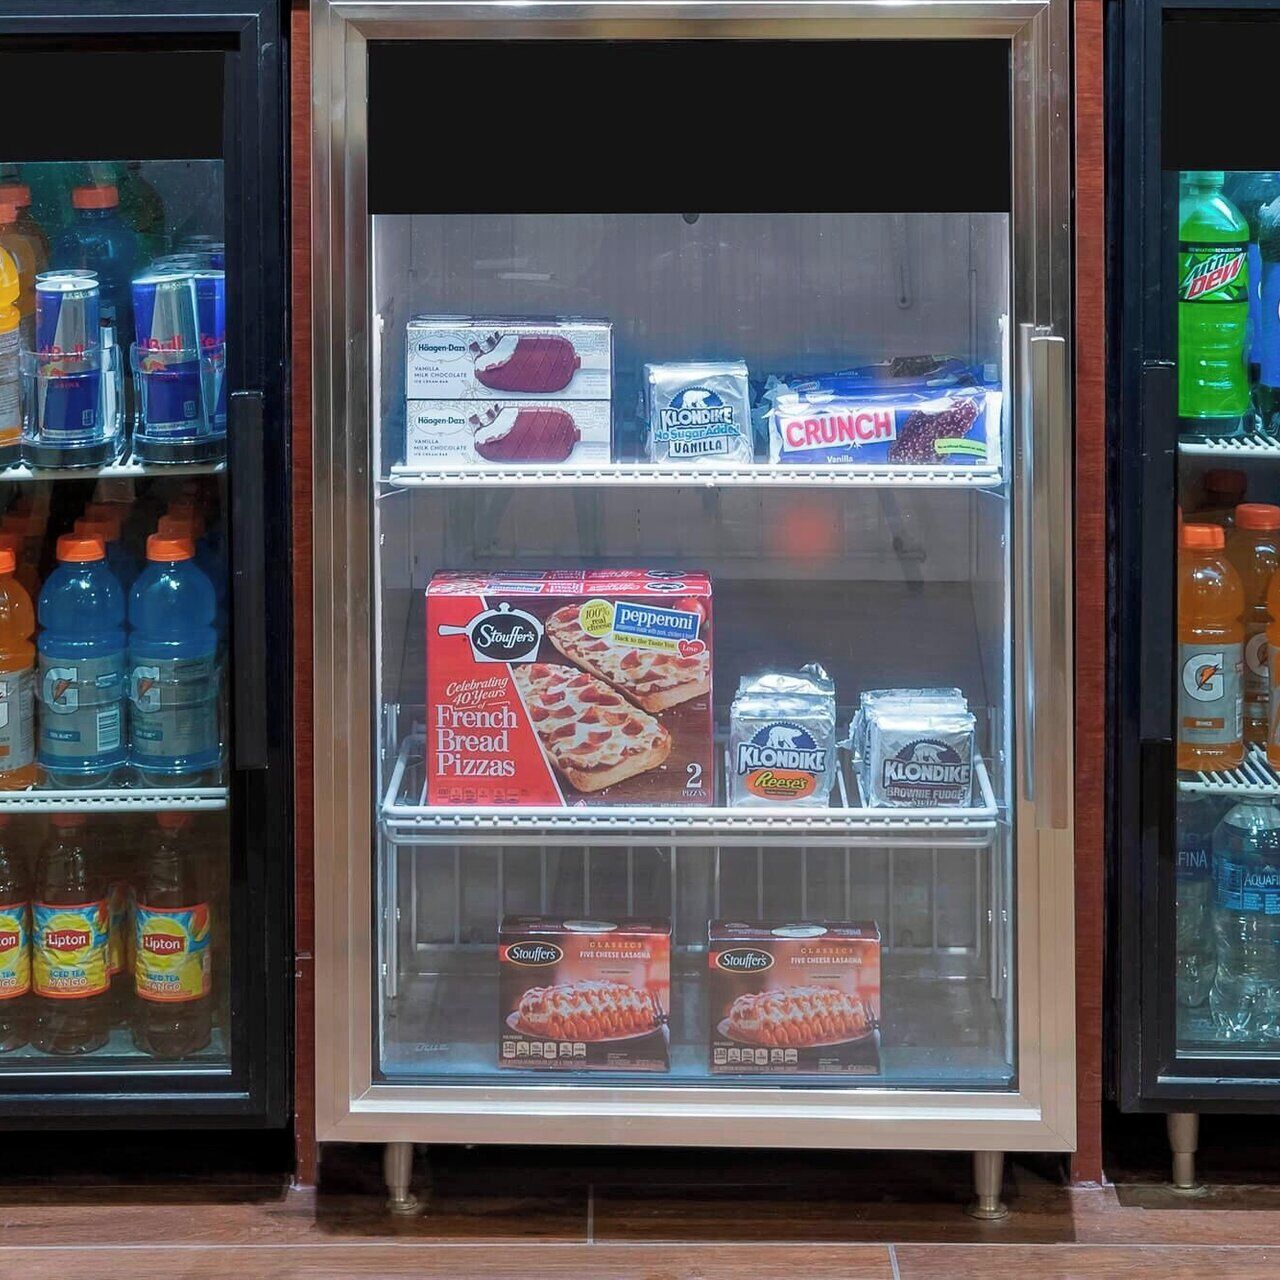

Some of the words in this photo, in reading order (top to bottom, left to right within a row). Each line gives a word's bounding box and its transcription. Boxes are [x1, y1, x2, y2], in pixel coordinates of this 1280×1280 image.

[660, 406, 733, 432] KLONDIKE
[655, 429, 669, 441] No
[670, 427, 706, 441] Sugar
[785, 411, 892, 448] CRUNCH
[674, 440, 723, 453] VANILLA
[827, 454, 853, 463] Vanilla
[621, 608, 693, 629] pepperoni
[477, 624, 534, 648] Stouffer's
[446, 676, 508, 697] Celebrating
[454, 694, 471, 706] 40
[471, 688, 506, 705] Years
[478, 702, 486, 710] of
[435, 705, 518, 728] French
[435, 728, 509, 752] Bread
[435, 753, 515, 777] Pizzas
[739, 743, 825, 774] KLONDIKE
[685, 763, 703, 788] 2
[883, 761, 969, 787] KLONDIKE
[887, 786, 931, 798] BROWNIE
[933, 787, 964, 799] FUDGE
[589, 941, 642, 949] CLASSICS
[511, 947, 556, 962] Stouffer's
[621, 951, 651, 959] LASAGNA
[722, 953, 767, 968] Stouffer's
[832, 957, 862, 965] LASAGNA
[2, 970, 16, 978] TEA
[48, 977, 87, 987] MANGO
